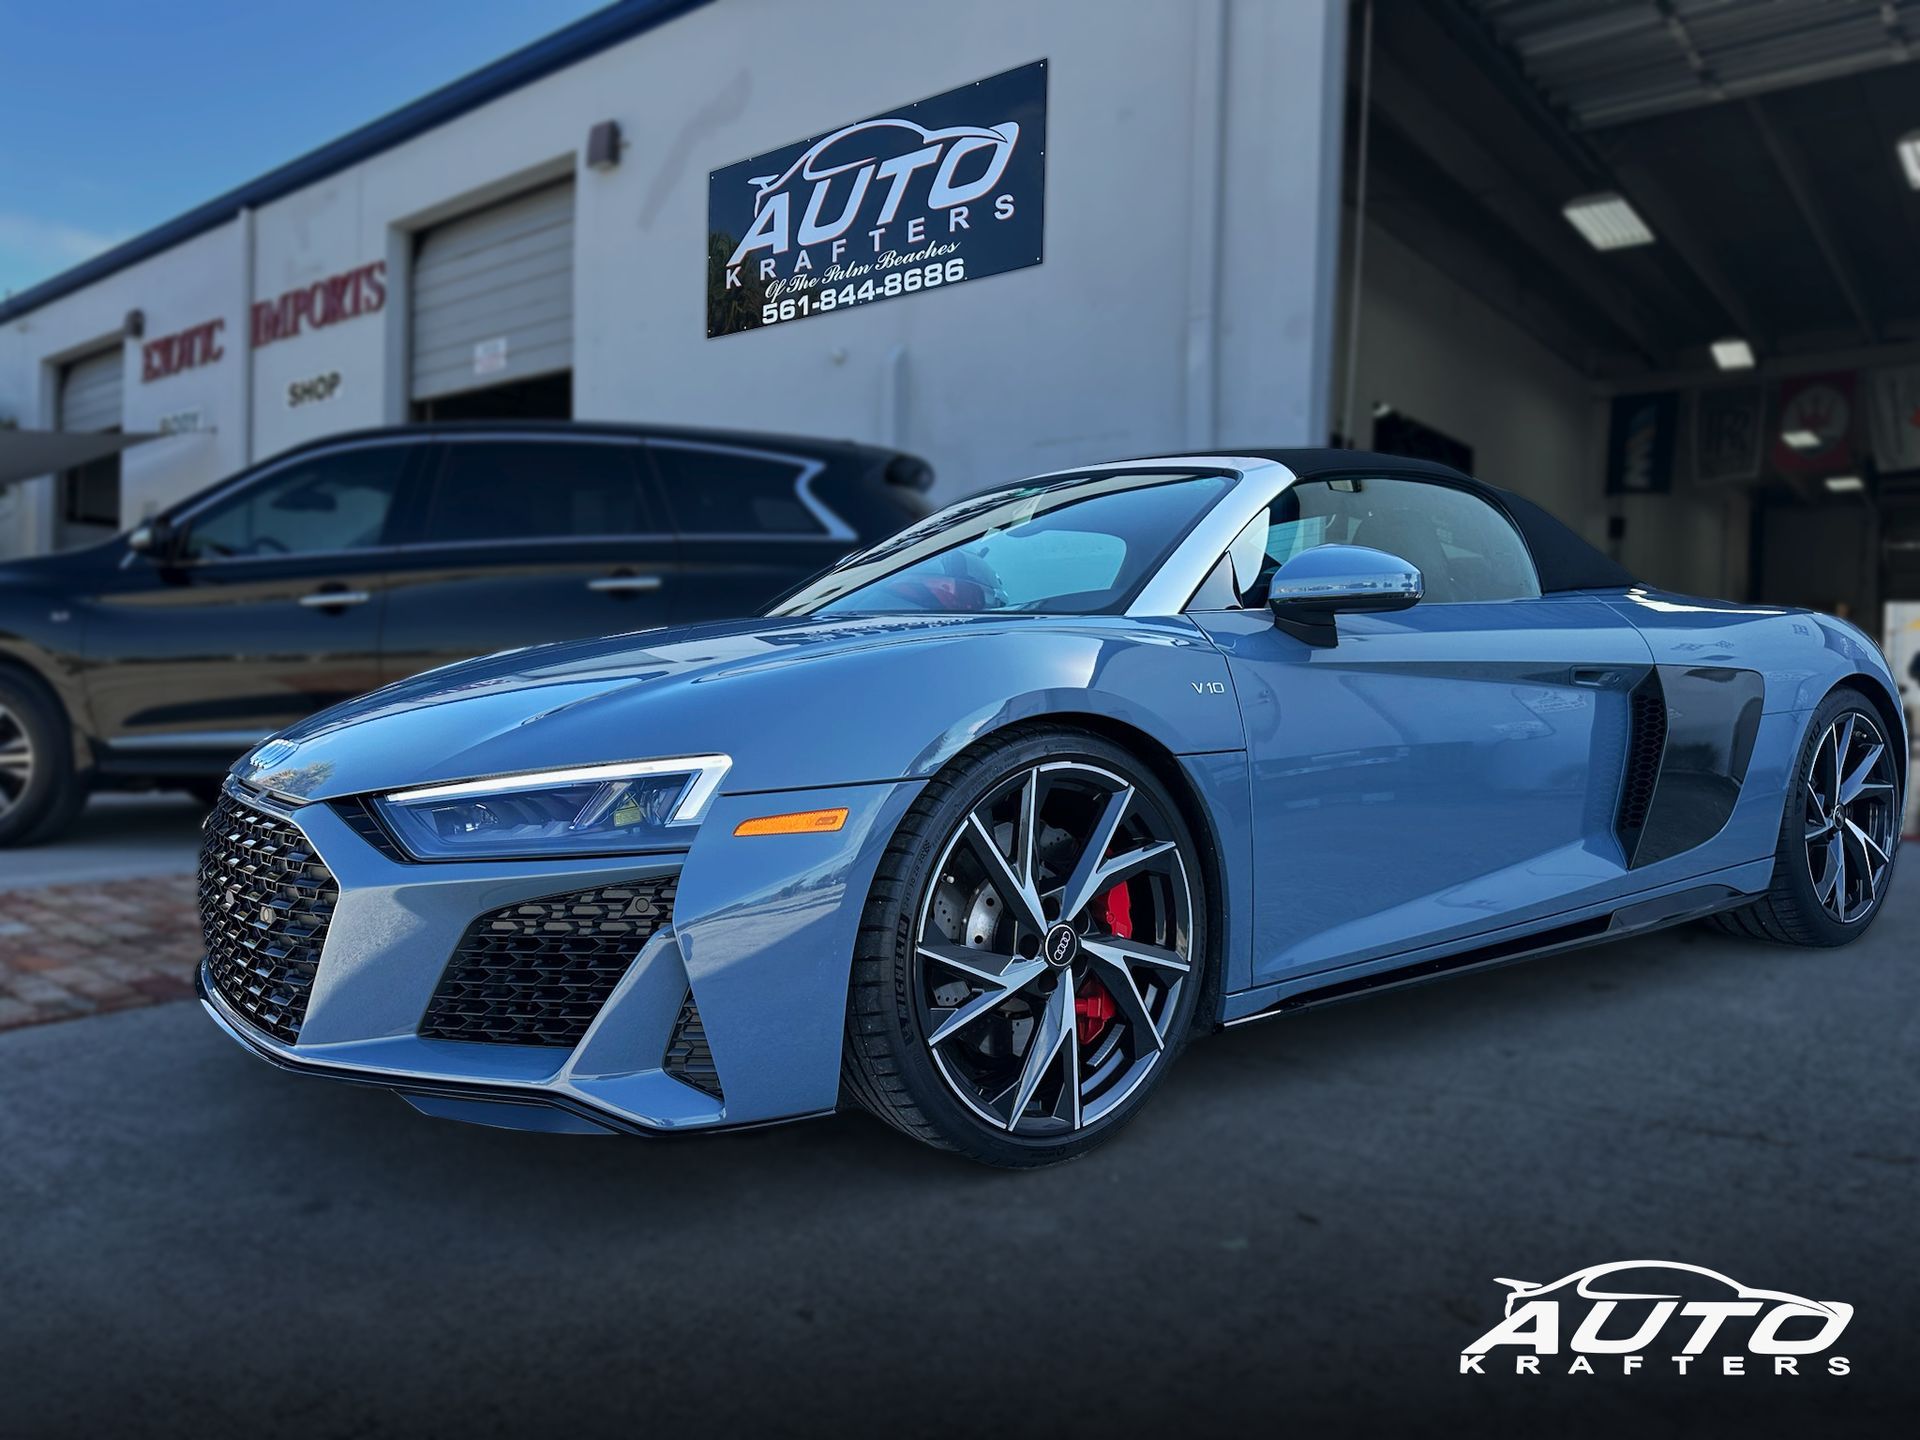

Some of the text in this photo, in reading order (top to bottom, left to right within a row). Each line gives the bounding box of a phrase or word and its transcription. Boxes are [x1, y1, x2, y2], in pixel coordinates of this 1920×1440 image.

[725, 121, 1019, 267] AUTO
[725, 193, 1015, 289] KRAFTERS
[765, 240, 961, 303] Of The Palm Beaches
[141, 260, 387, 385] EXOTIC IMPORTS
[761, 257, 965, 325] 561-844-8686
[288, 371, 341, 408] SHOP
[1190, 681, 1225, 695] V10
[894, 918, 909, 1019] MICHELIN
